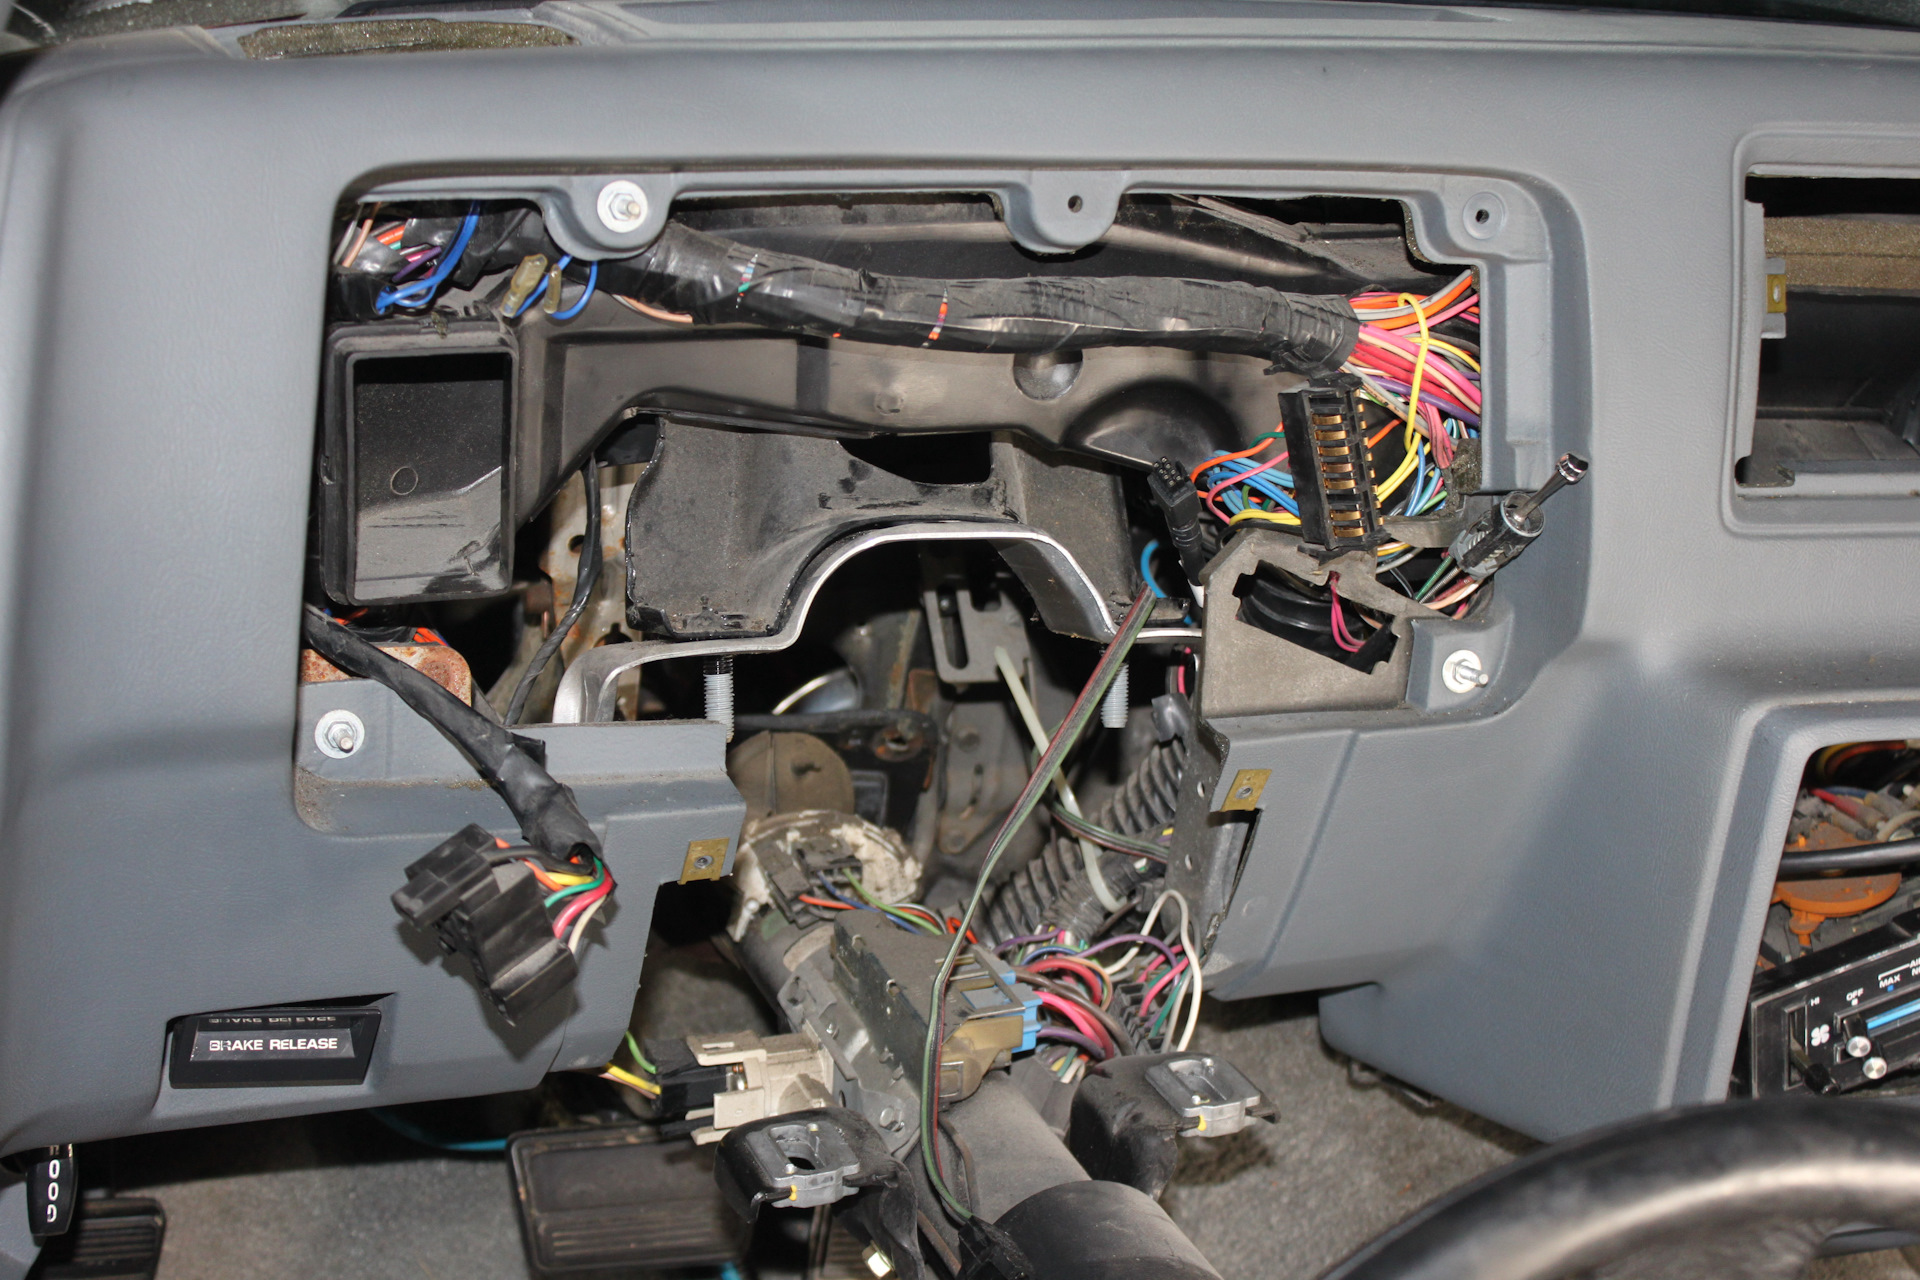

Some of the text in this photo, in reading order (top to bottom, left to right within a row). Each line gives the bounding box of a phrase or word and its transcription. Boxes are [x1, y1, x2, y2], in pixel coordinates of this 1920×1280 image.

[1879, 974, 1901, 988] MAX
[1846, 988, 1864, 1001] OFF
[1810, 997, 1820, 1006] HI
[210, 1038, 338, 1051] BRAKE RELEASE
